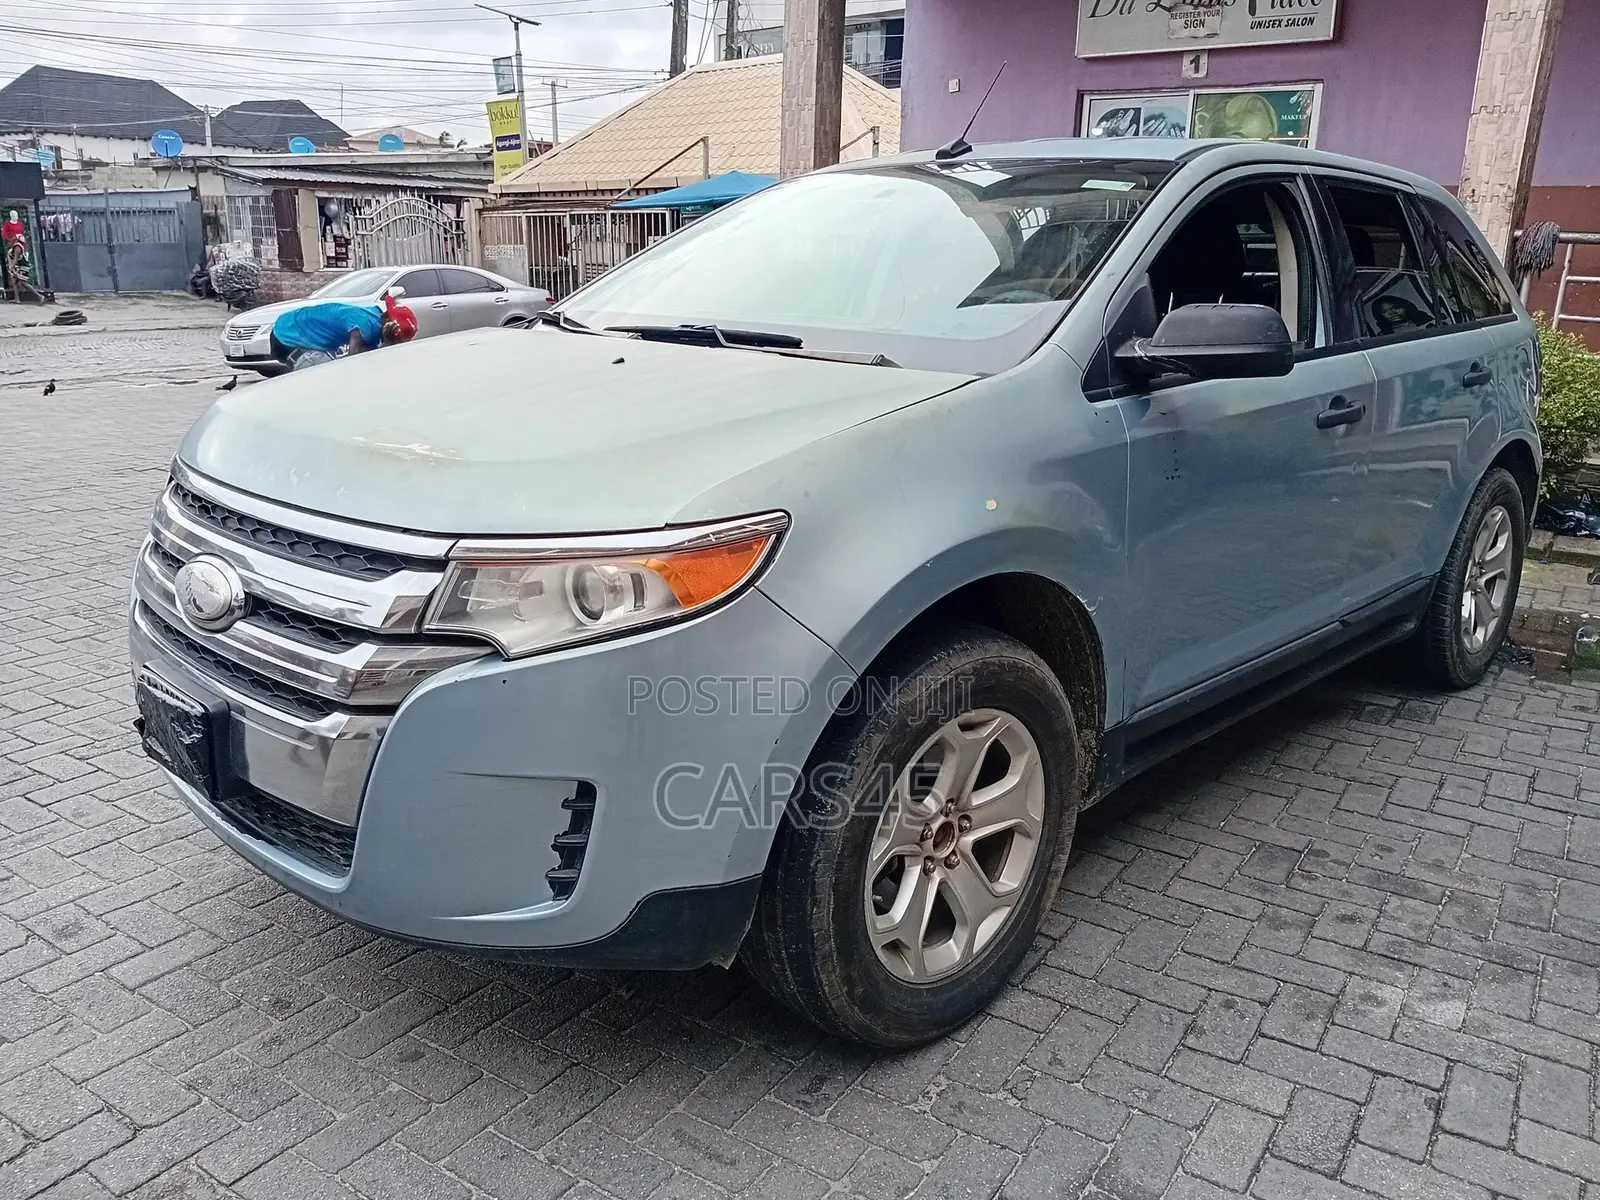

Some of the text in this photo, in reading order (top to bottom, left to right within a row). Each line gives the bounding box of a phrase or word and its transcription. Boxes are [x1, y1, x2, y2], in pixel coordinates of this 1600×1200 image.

[1170, 9, 1221, 20] REGISTER YOUR
[1184, 18, 1206, 30] SIGN
[1250, 17, 1315, 30] UNISEX SALON
[1189, 55, 1200, 75] 1
